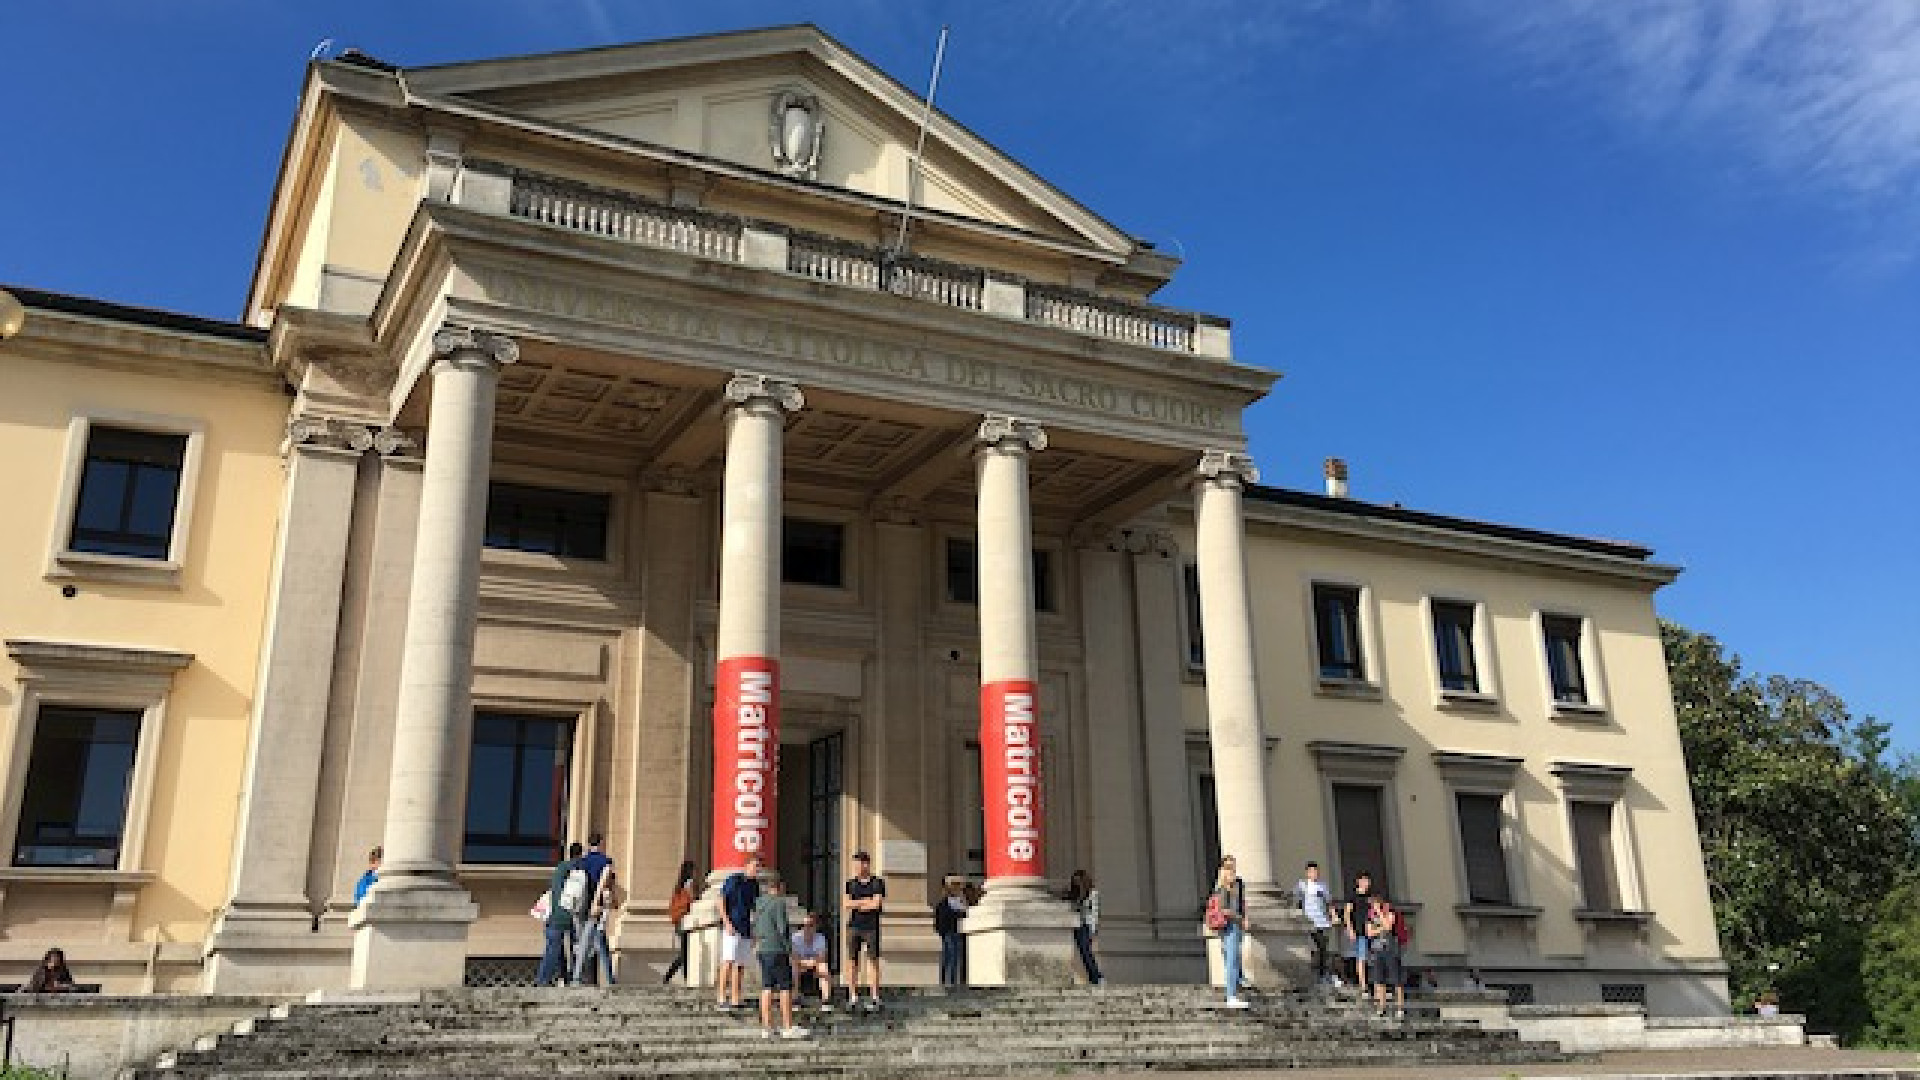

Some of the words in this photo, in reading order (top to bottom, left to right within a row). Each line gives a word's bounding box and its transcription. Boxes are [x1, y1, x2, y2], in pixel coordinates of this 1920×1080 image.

[738, 318, 928, 378] CATTOLICA
[944, 357, 1002, 392] DEL
[1017, 368, 1115, 413] SACRO
[1128, 388, 1225, 430] CUORE
[734, 671, 772, 853] Matricole
[1004, 692, 1039, 862] Matricole
